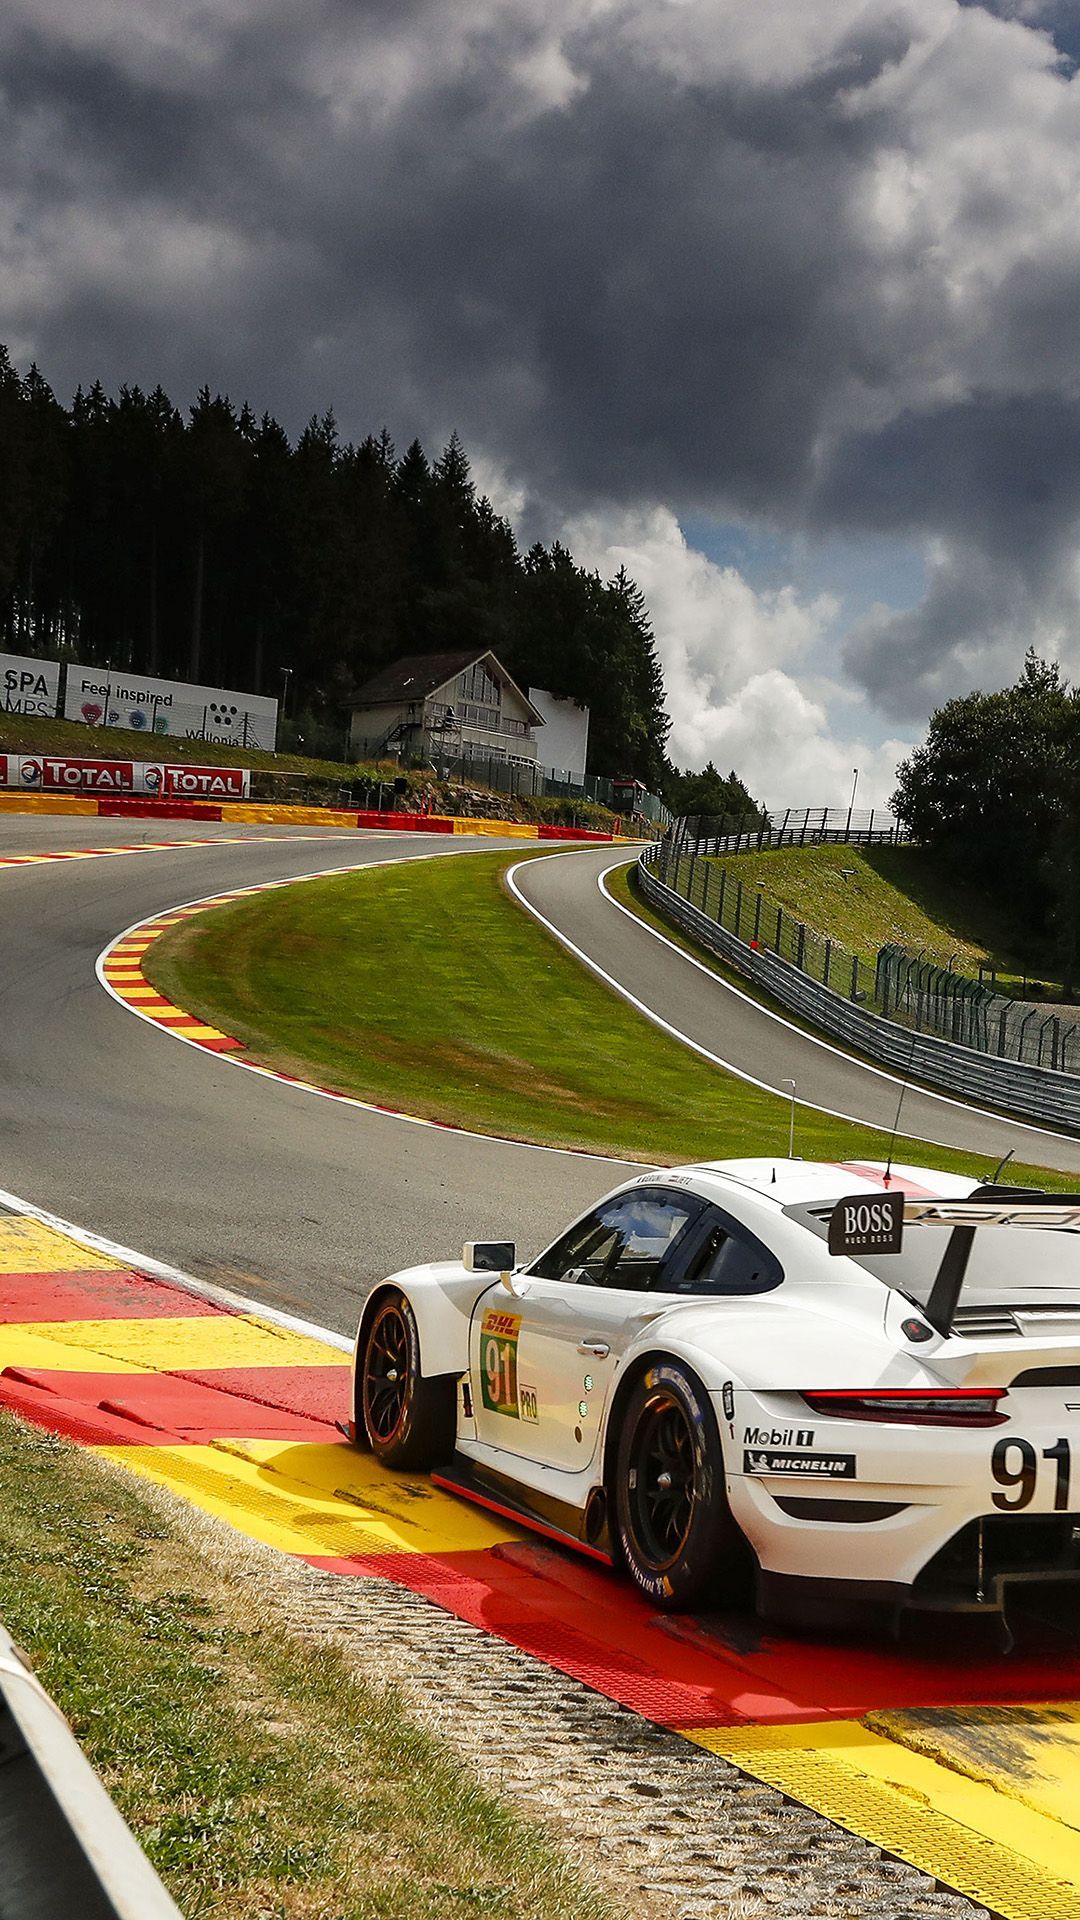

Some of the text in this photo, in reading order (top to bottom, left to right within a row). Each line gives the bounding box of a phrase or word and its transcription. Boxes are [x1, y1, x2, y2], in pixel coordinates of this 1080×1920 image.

[4, 669, 48, 696] SPA
[82, 680, 173, 706] Feel inspired
[47, 762, 130, 787] TOTAL
[167, 769, 240, 793] TOTAL
[844, 1203, 893, 1234] BOSS
[845, 1234, 893, 1244] HUGO BOSS
[485, 1313, 516, 1335] DHL
[485, 1339, 512, 1405] 91
[520, 1390, 537, 1419] PRO
[743, 1427, 812, 1446] Mobil 1
[771, 1459, 847, 1471] MICHELIN
[991, 1437, 1071, 1511] 91
